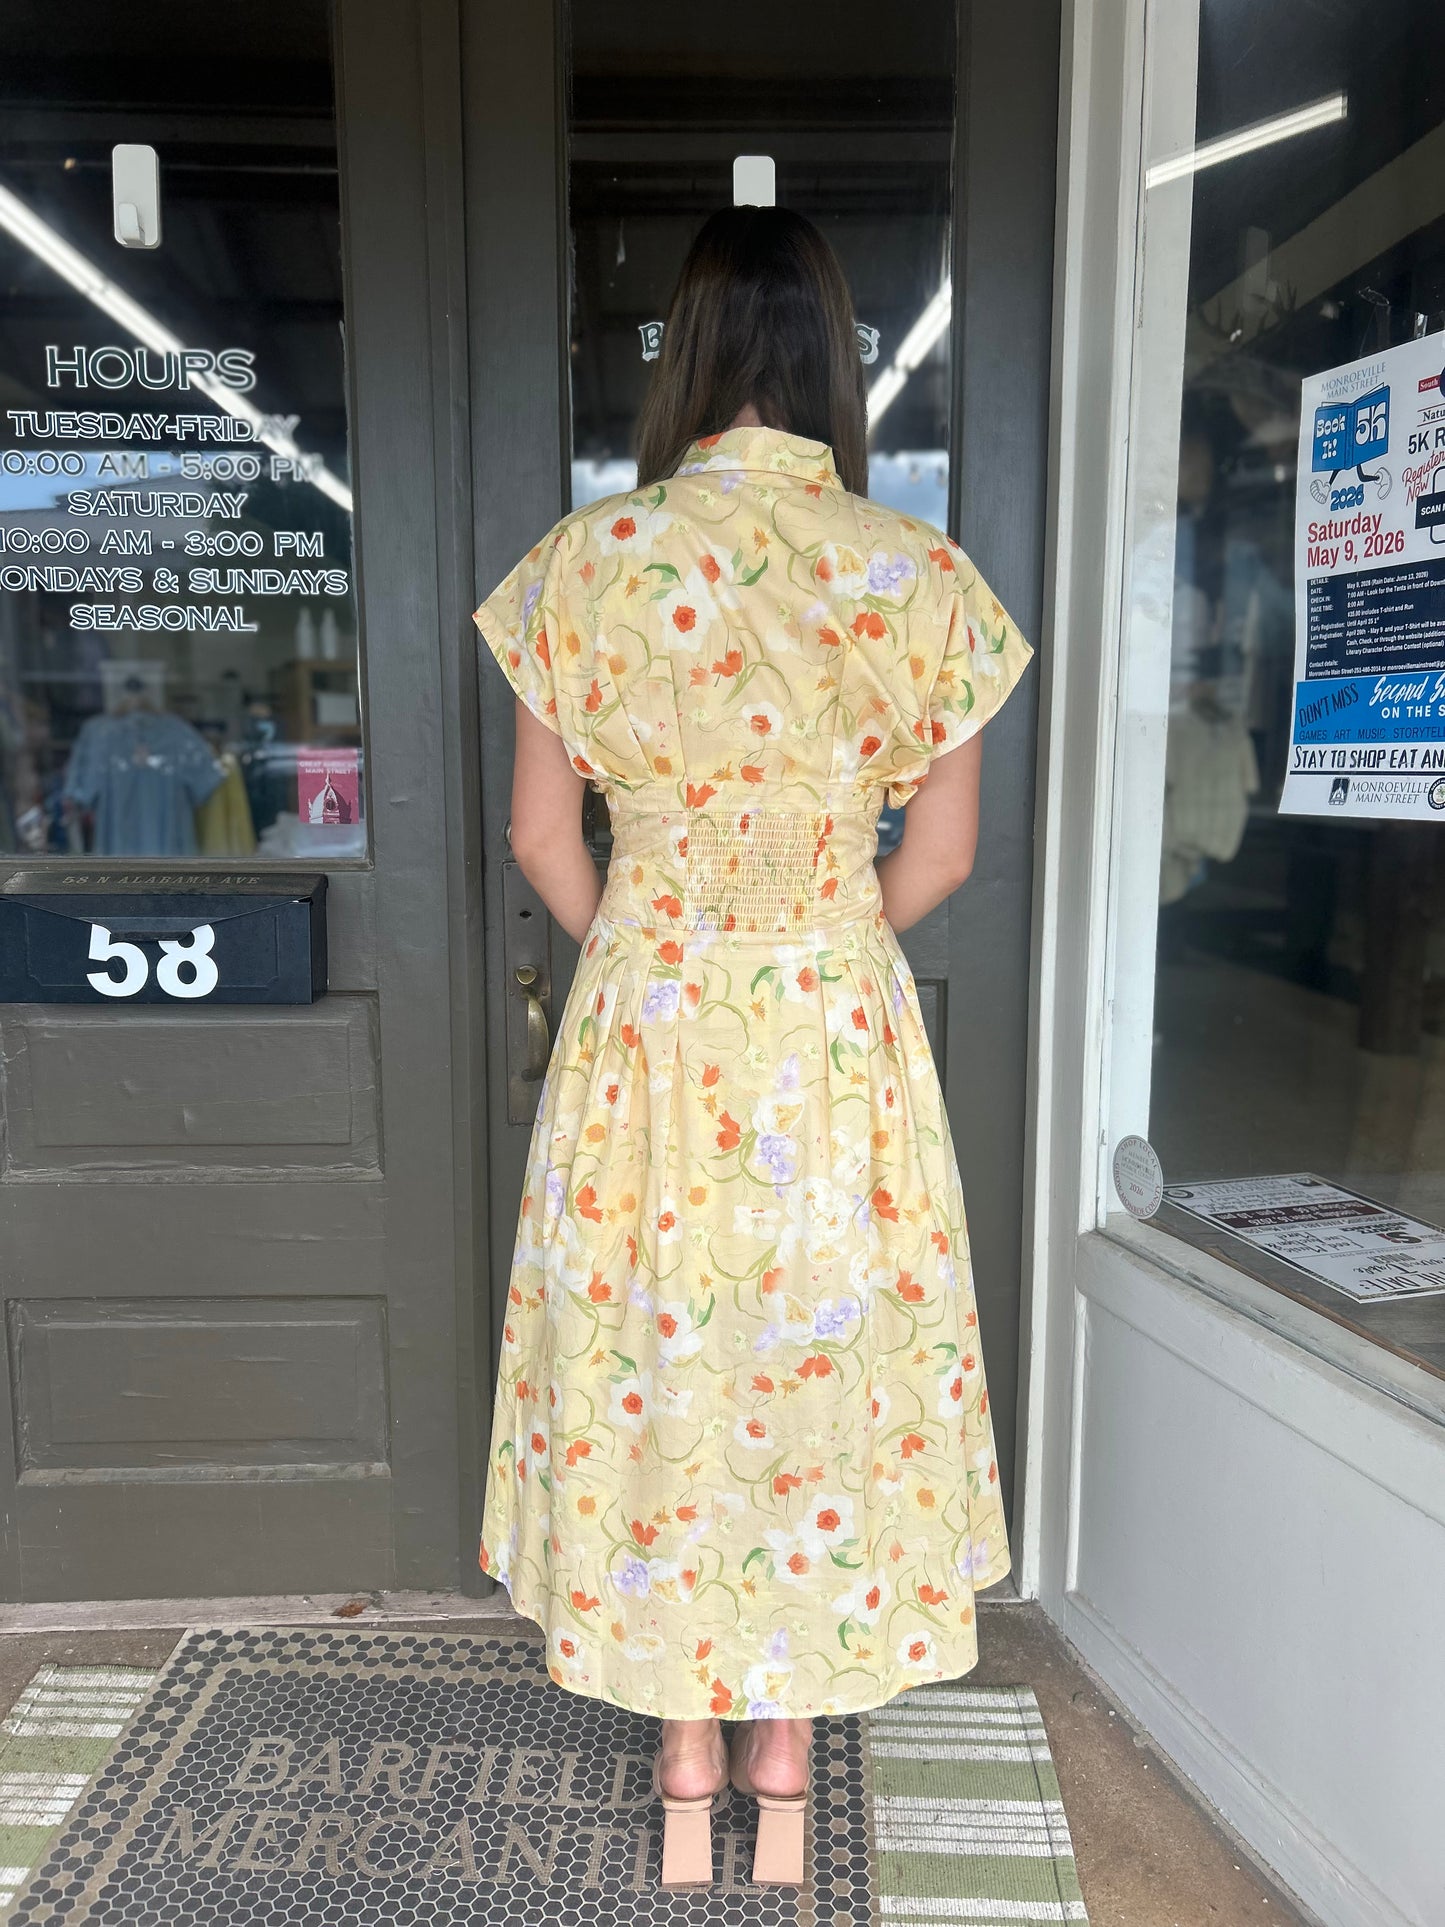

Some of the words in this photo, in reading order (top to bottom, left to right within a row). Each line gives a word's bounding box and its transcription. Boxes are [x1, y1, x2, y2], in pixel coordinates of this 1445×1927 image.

[46, 346, 256, 392] HOURS
[1321, 362, 1386, 393] MONROEVILLE
[1326, 385, 1349, 400] MAIN
[1350, 376, 1378, 393] STREET
[7, 410, 300, 442] TUESDAY-FRIDAY
[1316, 413, 1346, 438] Book
[1355, 402, 1387, 446] 5K
[1322, 439, 1337, 460] It!
[1408, 430, 1429, 454] 5K
[0, 450, 85, 477] 0:00
[96, 453, 148, 478] AM
[181, 454, 260, 482] 5:00
[1402, 450, 1445, 487] Register
[1330, 484, 1364, 512] 2026
[1406, 473, 1430, 506] Now
[67, 490, 248, 518] SATURDAY
[1421, 504, 1440, 516] SCAN
[1308, 512, 1382, 543] Saturday
[100, 530, 152, 555] AM
[184, 531, 263, 556] 3:00
[274, 532, 324, 557] PM
[1307, 545, 1339, 568] May
[1344, 540, 1358, 564] 9,
[1364, 530, 1405, 558] 2026
[0, 565, 143, 592] ONDAYS
[153, 568, 179, 594] &
[188, 570, 348, 595] SUNDAYS
[69, 604, 258, 632] SEASONAL
[1298, 694, 1330, 728] DON'T
[1332, 682, 1358, 711] MISS
[1369, 676, 1429, 706] Second
[1381, 707, 1400, 718] ON
[1406, 705, 1431, 718] THE
[1299, 729, 1327, 741] GAMES
[1334, 728, 1351, 740] ART
[1358, 728, 1386, 739] MUSIC
[1294, 746, 1327, 768] STAY
[1331, 750, 1346, 768] TO
[1350, 749, 1386, 768] SHOP
[1390, 749, 1418, 768] EAT
[1350, 781, 1430, 794] MONROEVILLE
[1356, 793, 1382, 803] MAIN
[1384, 794, 1420, 804] STREET
[62, 876, 89, 884] 58
[96, 876, 110, 884] N
[118, 876, 210, 884] ALABAMA
[220, 876, 260, 884] AVE
[86, 924, 219, 998] 58
[1120, 1140, 1137, 1152] SHOP
[1140, 1140, 1158, 1168] LOCAL
[1129, 1183, 1144, 1196] 2026
[142, 1804, 766, 1894] MERCANTIE
